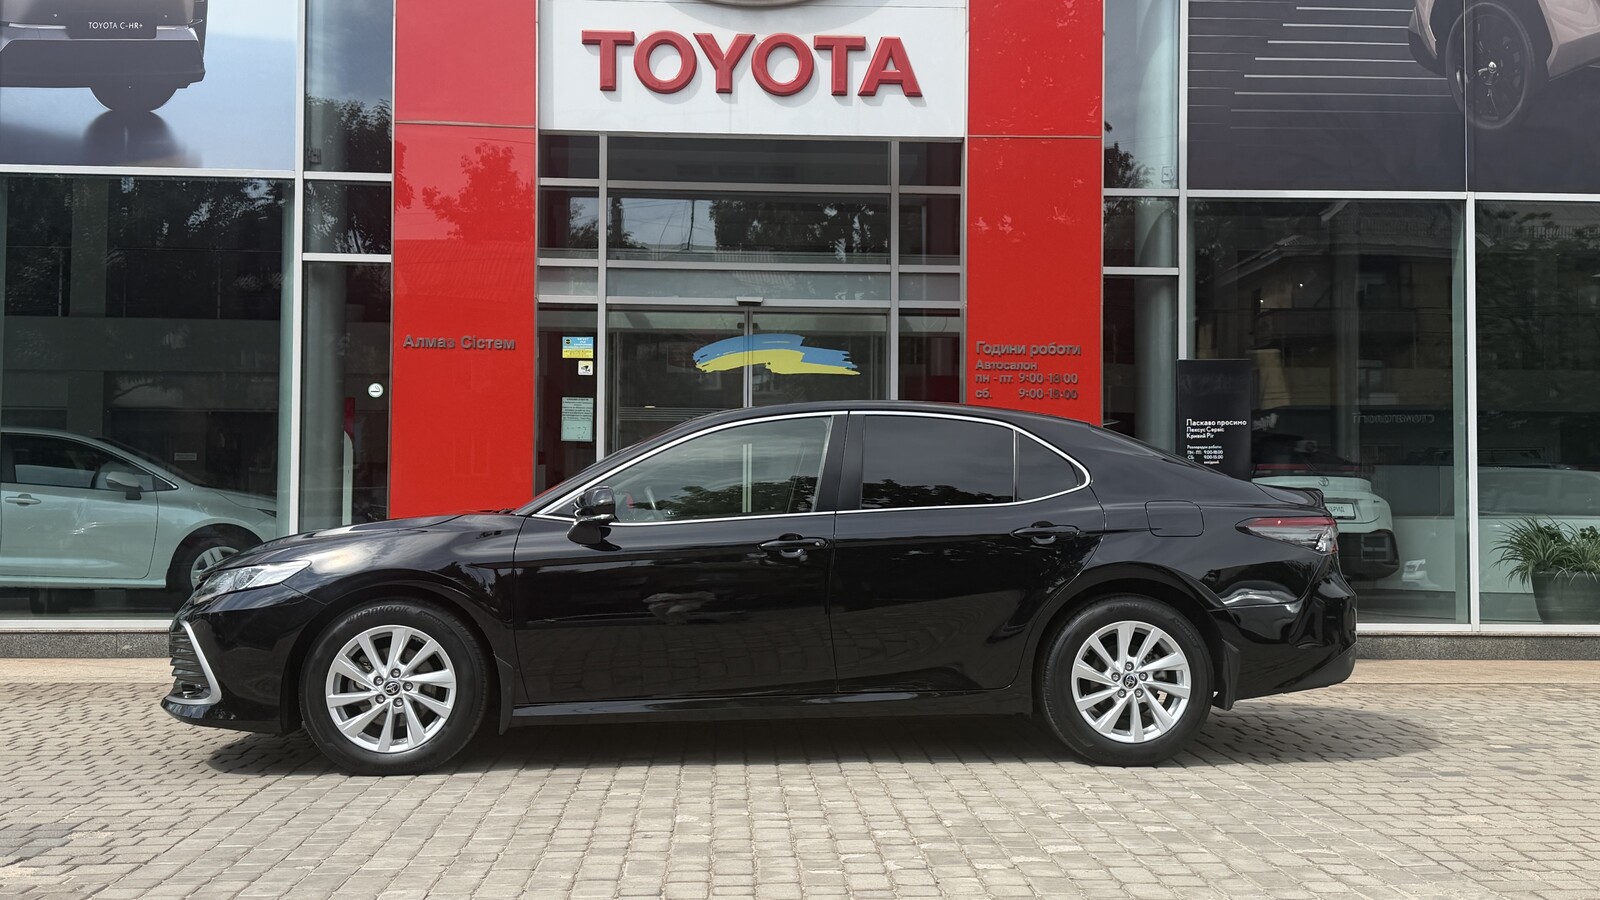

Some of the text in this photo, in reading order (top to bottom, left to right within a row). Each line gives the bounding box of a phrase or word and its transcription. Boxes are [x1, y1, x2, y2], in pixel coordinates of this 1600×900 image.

[88, 21, 143, 29] TOYOTA C-HR+
[581, 30, 923, 97] TOYOTA
[403, 335, 516, 350] Алмаз Сістем
[975, 340, 1082, 358] Години роботи
[975, 359, 1038, 371] Автосалон
